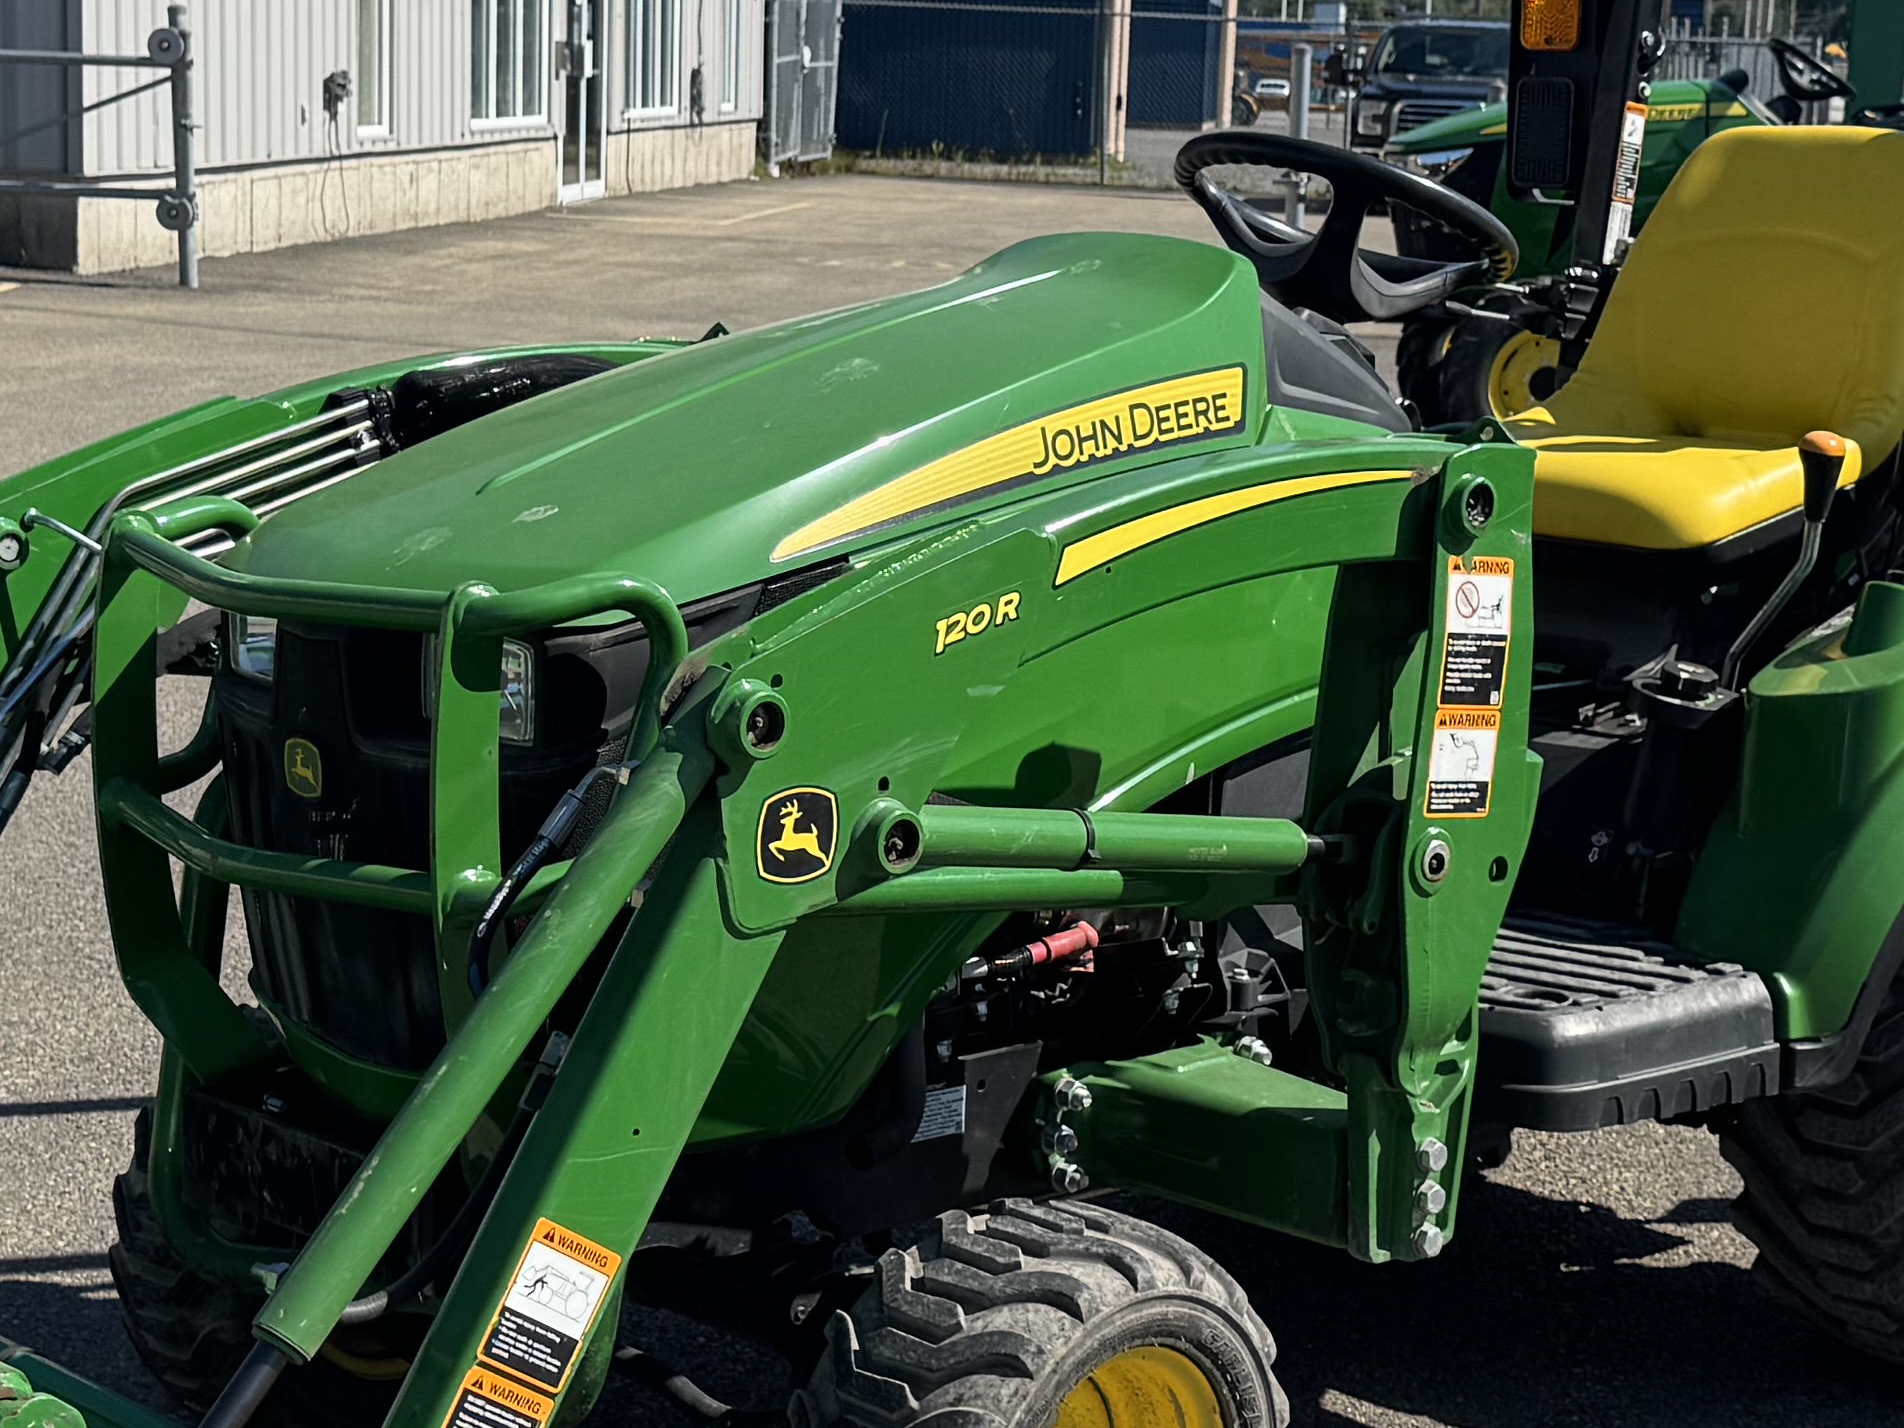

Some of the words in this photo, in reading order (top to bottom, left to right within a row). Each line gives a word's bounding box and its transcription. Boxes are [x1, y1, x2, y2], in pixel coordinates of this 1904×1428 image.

[1033, 415, 1123, 469] JOHN
[1128, 392, 1231, 442] DEERE
[1469, 560, 1509, 574] ARNING
[1448, 714, 1496, 726] WARNING
[557, 1233, 609, 1268] WARNING
[488, 1381, 542, 1415] WARNING
